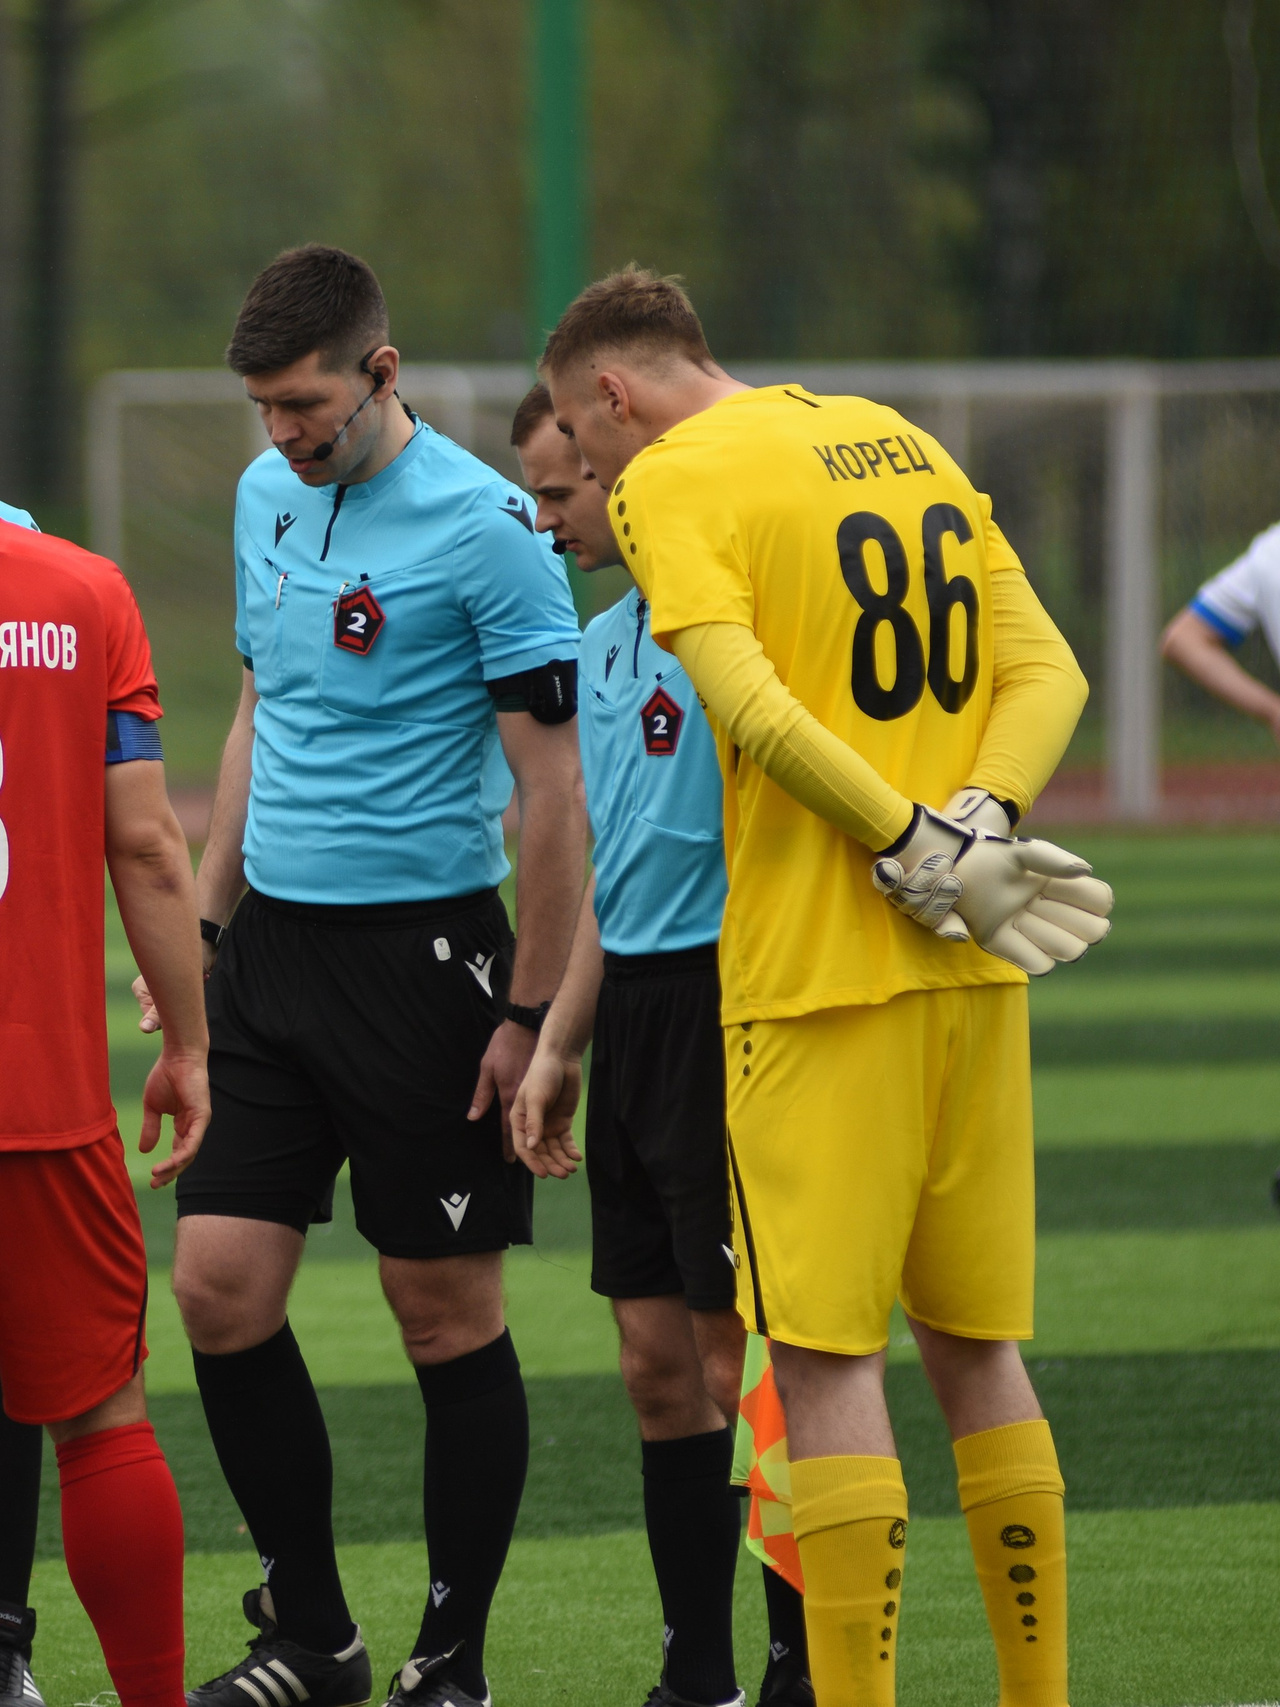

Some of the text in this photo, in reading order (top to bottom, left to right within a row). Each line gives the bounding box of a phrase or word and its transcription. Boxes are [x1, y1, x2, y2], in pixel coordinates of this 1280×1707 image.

[812, 434, 936, 481] КОРЕЦ
[347, 612, 367, 634] 2
[837, 502, 980, 722] 86
[653, 714, 668, 734] 2
